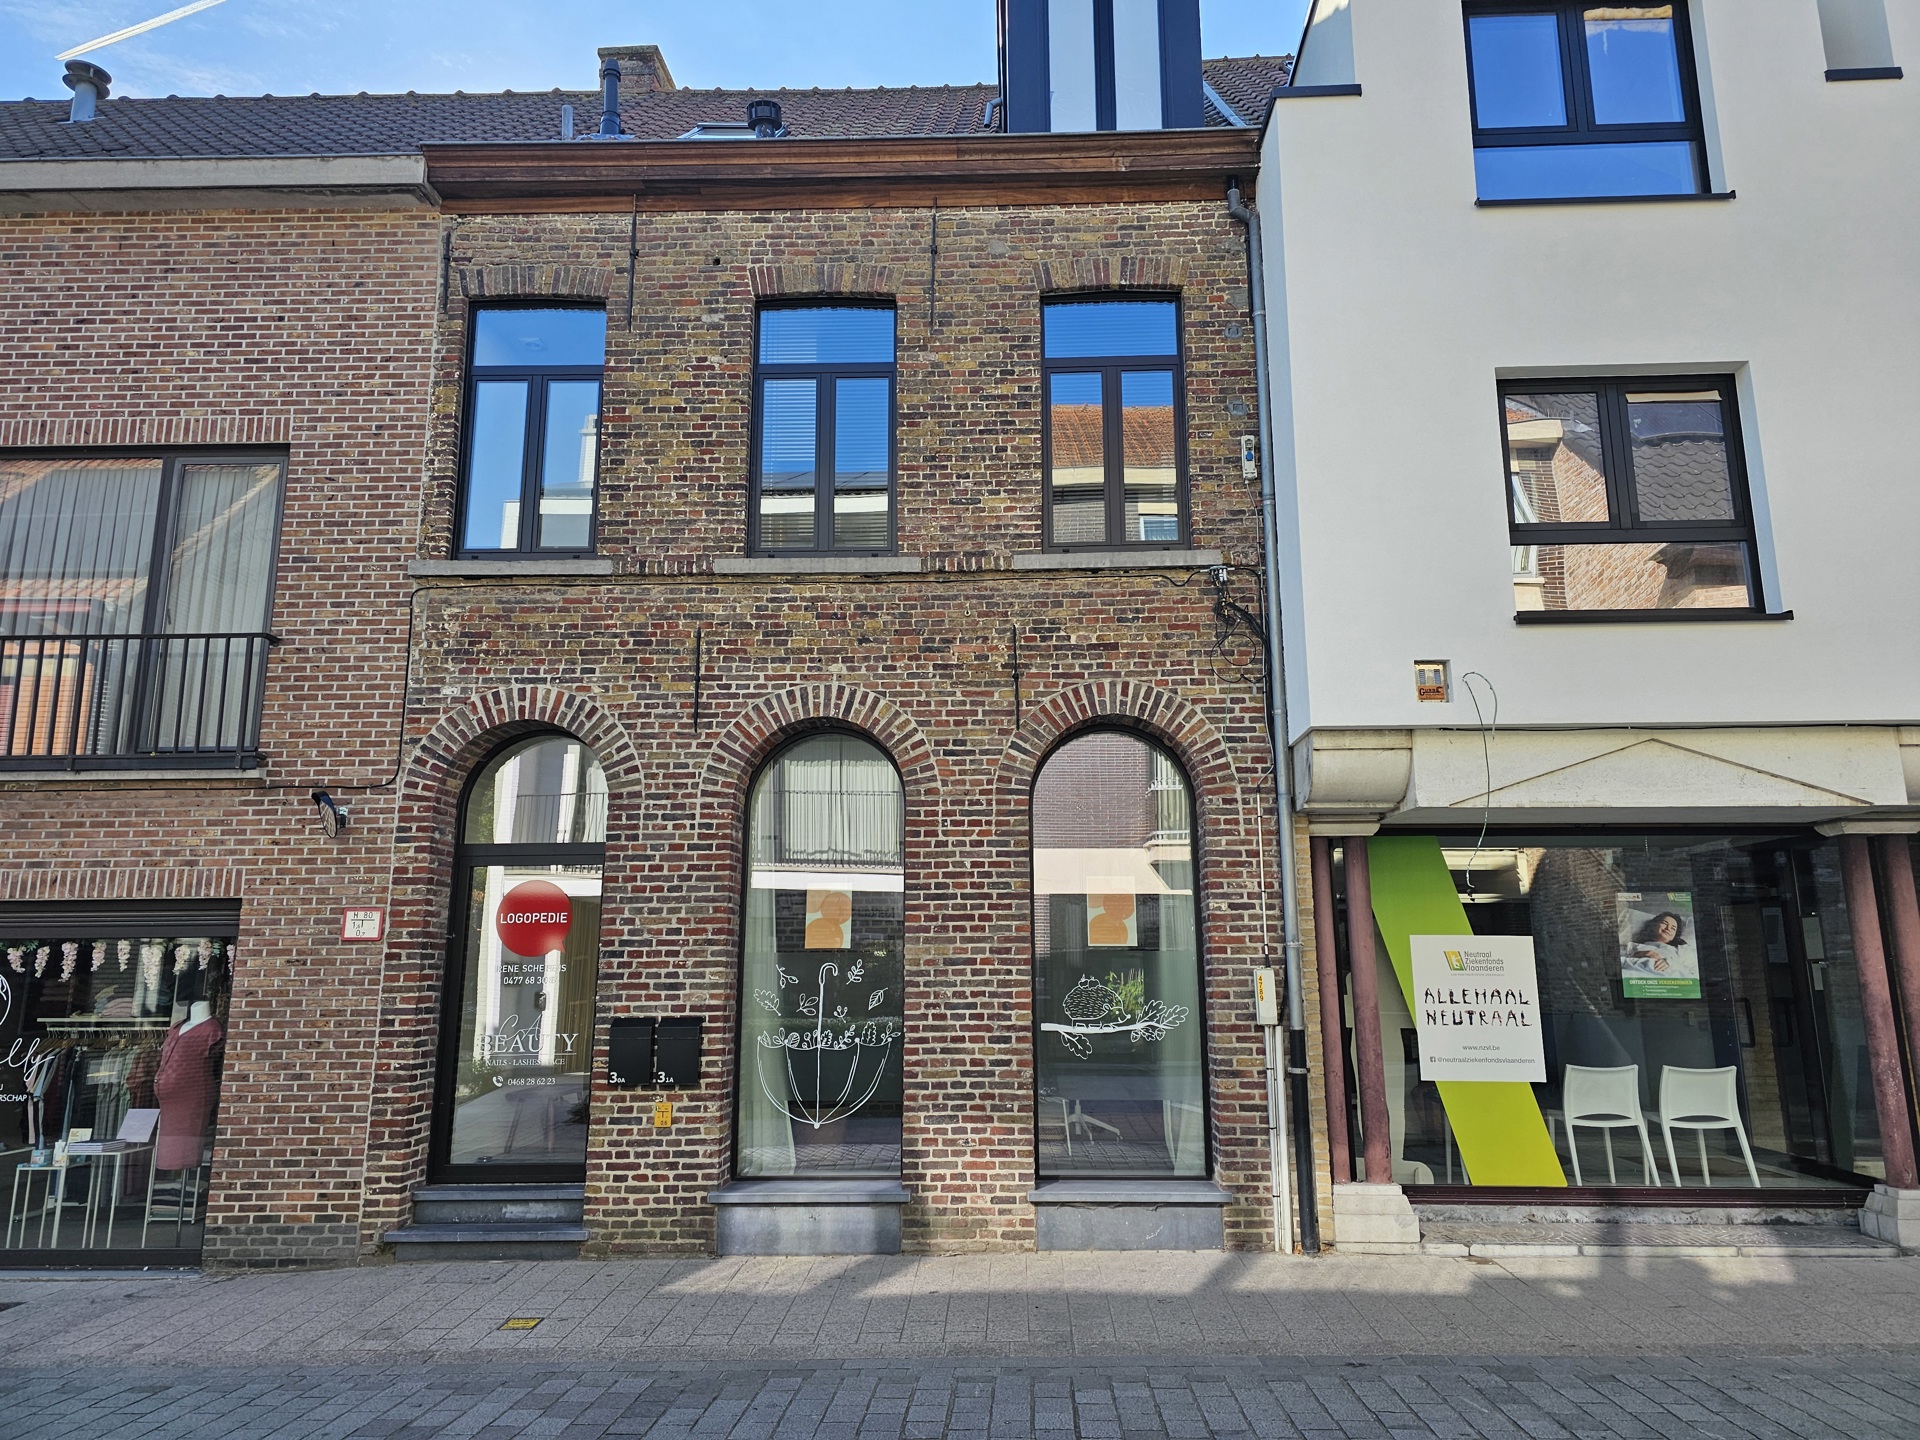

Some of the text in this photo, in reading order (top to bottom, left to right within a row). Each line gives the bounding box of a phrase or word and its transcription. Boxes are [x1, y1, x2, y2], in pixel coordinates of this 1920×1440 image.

[363, 911, 374, 919] 80
[500, 912, 568, 924] LOGOPEDIE
[503, 976, 523, 985] 0477
[524, 976, 535, 985] 68
[1424, 988, 1531, 1005] ALLEMAAL
[1426, 1010, 1533, 1027] NEUTRAAL
[478, 1032, 579, 1053] BEAUTY
[484, 1059, 508, 1067] NAILS
[1437, 1056, 1535, 1064] @neutraalziekenfondsvlaanderen
[507, 1077, 556, 1086] 0468 28 62 23
